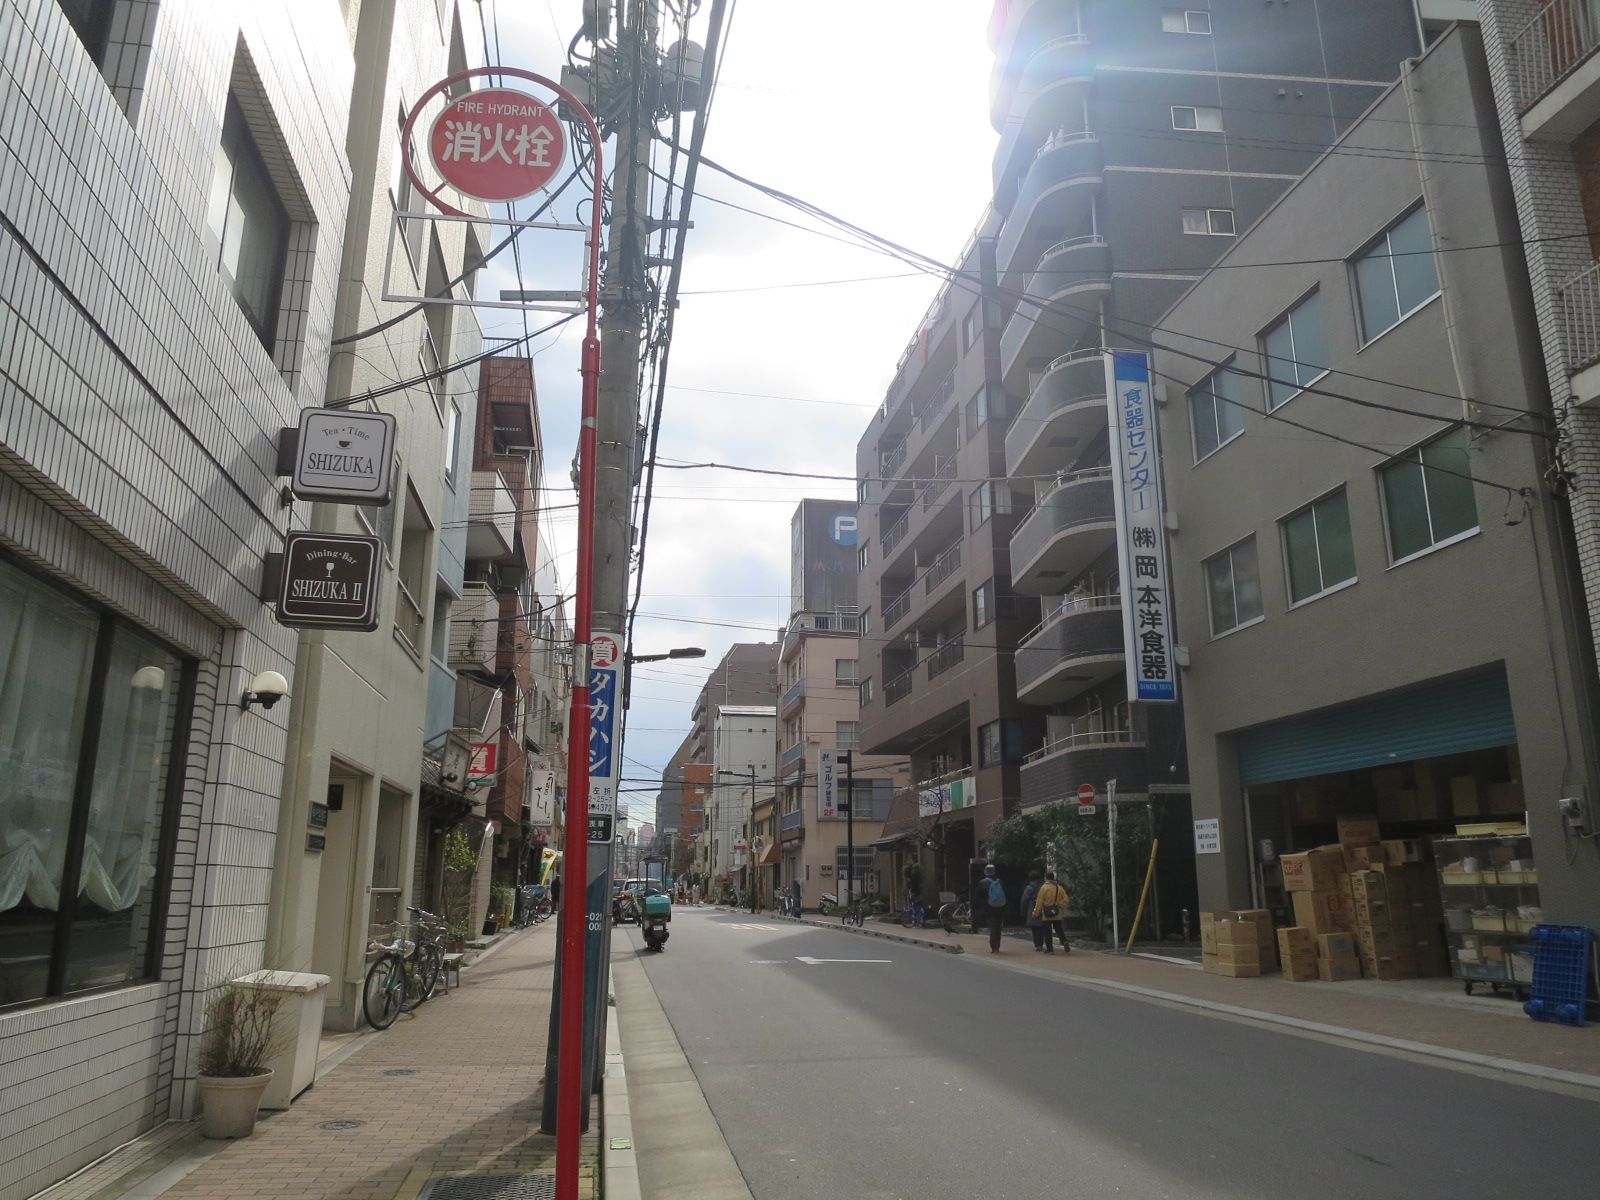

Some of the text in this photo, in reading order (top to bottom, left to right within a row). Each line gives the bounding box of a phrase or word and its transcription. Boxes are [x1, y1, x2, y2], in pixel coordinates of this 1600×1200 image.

[457, 101, 544, 118] FIRE HYDRANT
[442, 120, 554, 167] 消火栓
[1123, 388, 1149, 511] 食器センター
[307, 452, 374, 474] SHIZUKA
[834, 516, 857, 541] P
[292, 579, 348, 600] SHIZUKA
[592, 640, 616, 663] 質
[823, 809, 834, 817] 2F
